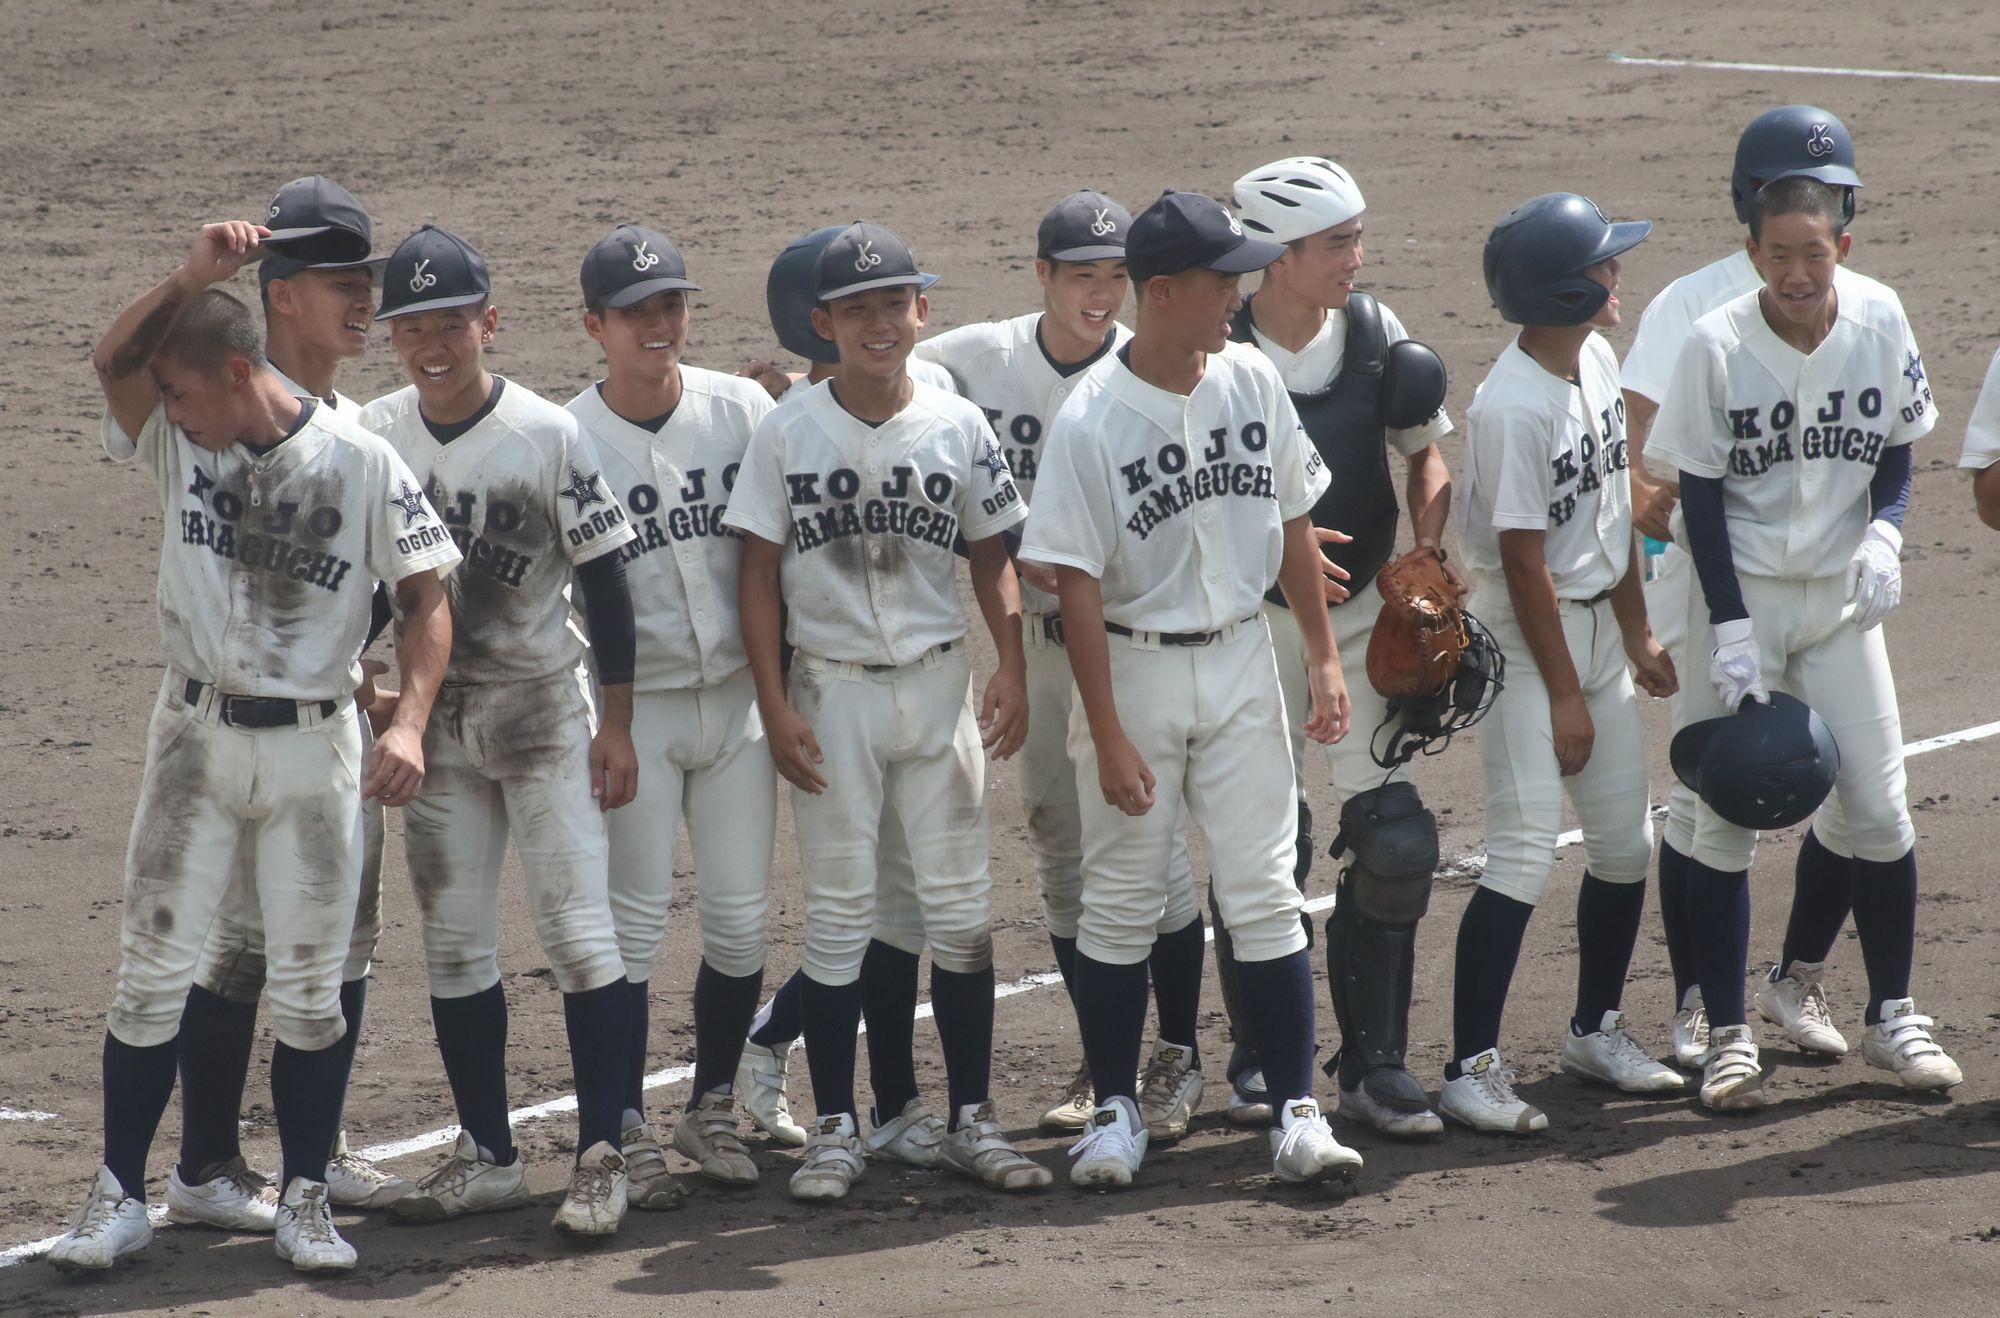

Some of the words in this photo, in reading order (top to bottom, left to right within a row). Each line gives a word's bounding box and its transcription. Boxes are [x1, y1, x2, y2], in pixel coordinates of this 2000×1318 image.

[1729, 387, 1882, 440] KOJO
[1120, 421, 1267, 495] KOJO
[627, 462, 740, 515] OJO
[785, 466, 953, 504] KOJO
[1126, 462, 1278, 541] YAMAGUCH
